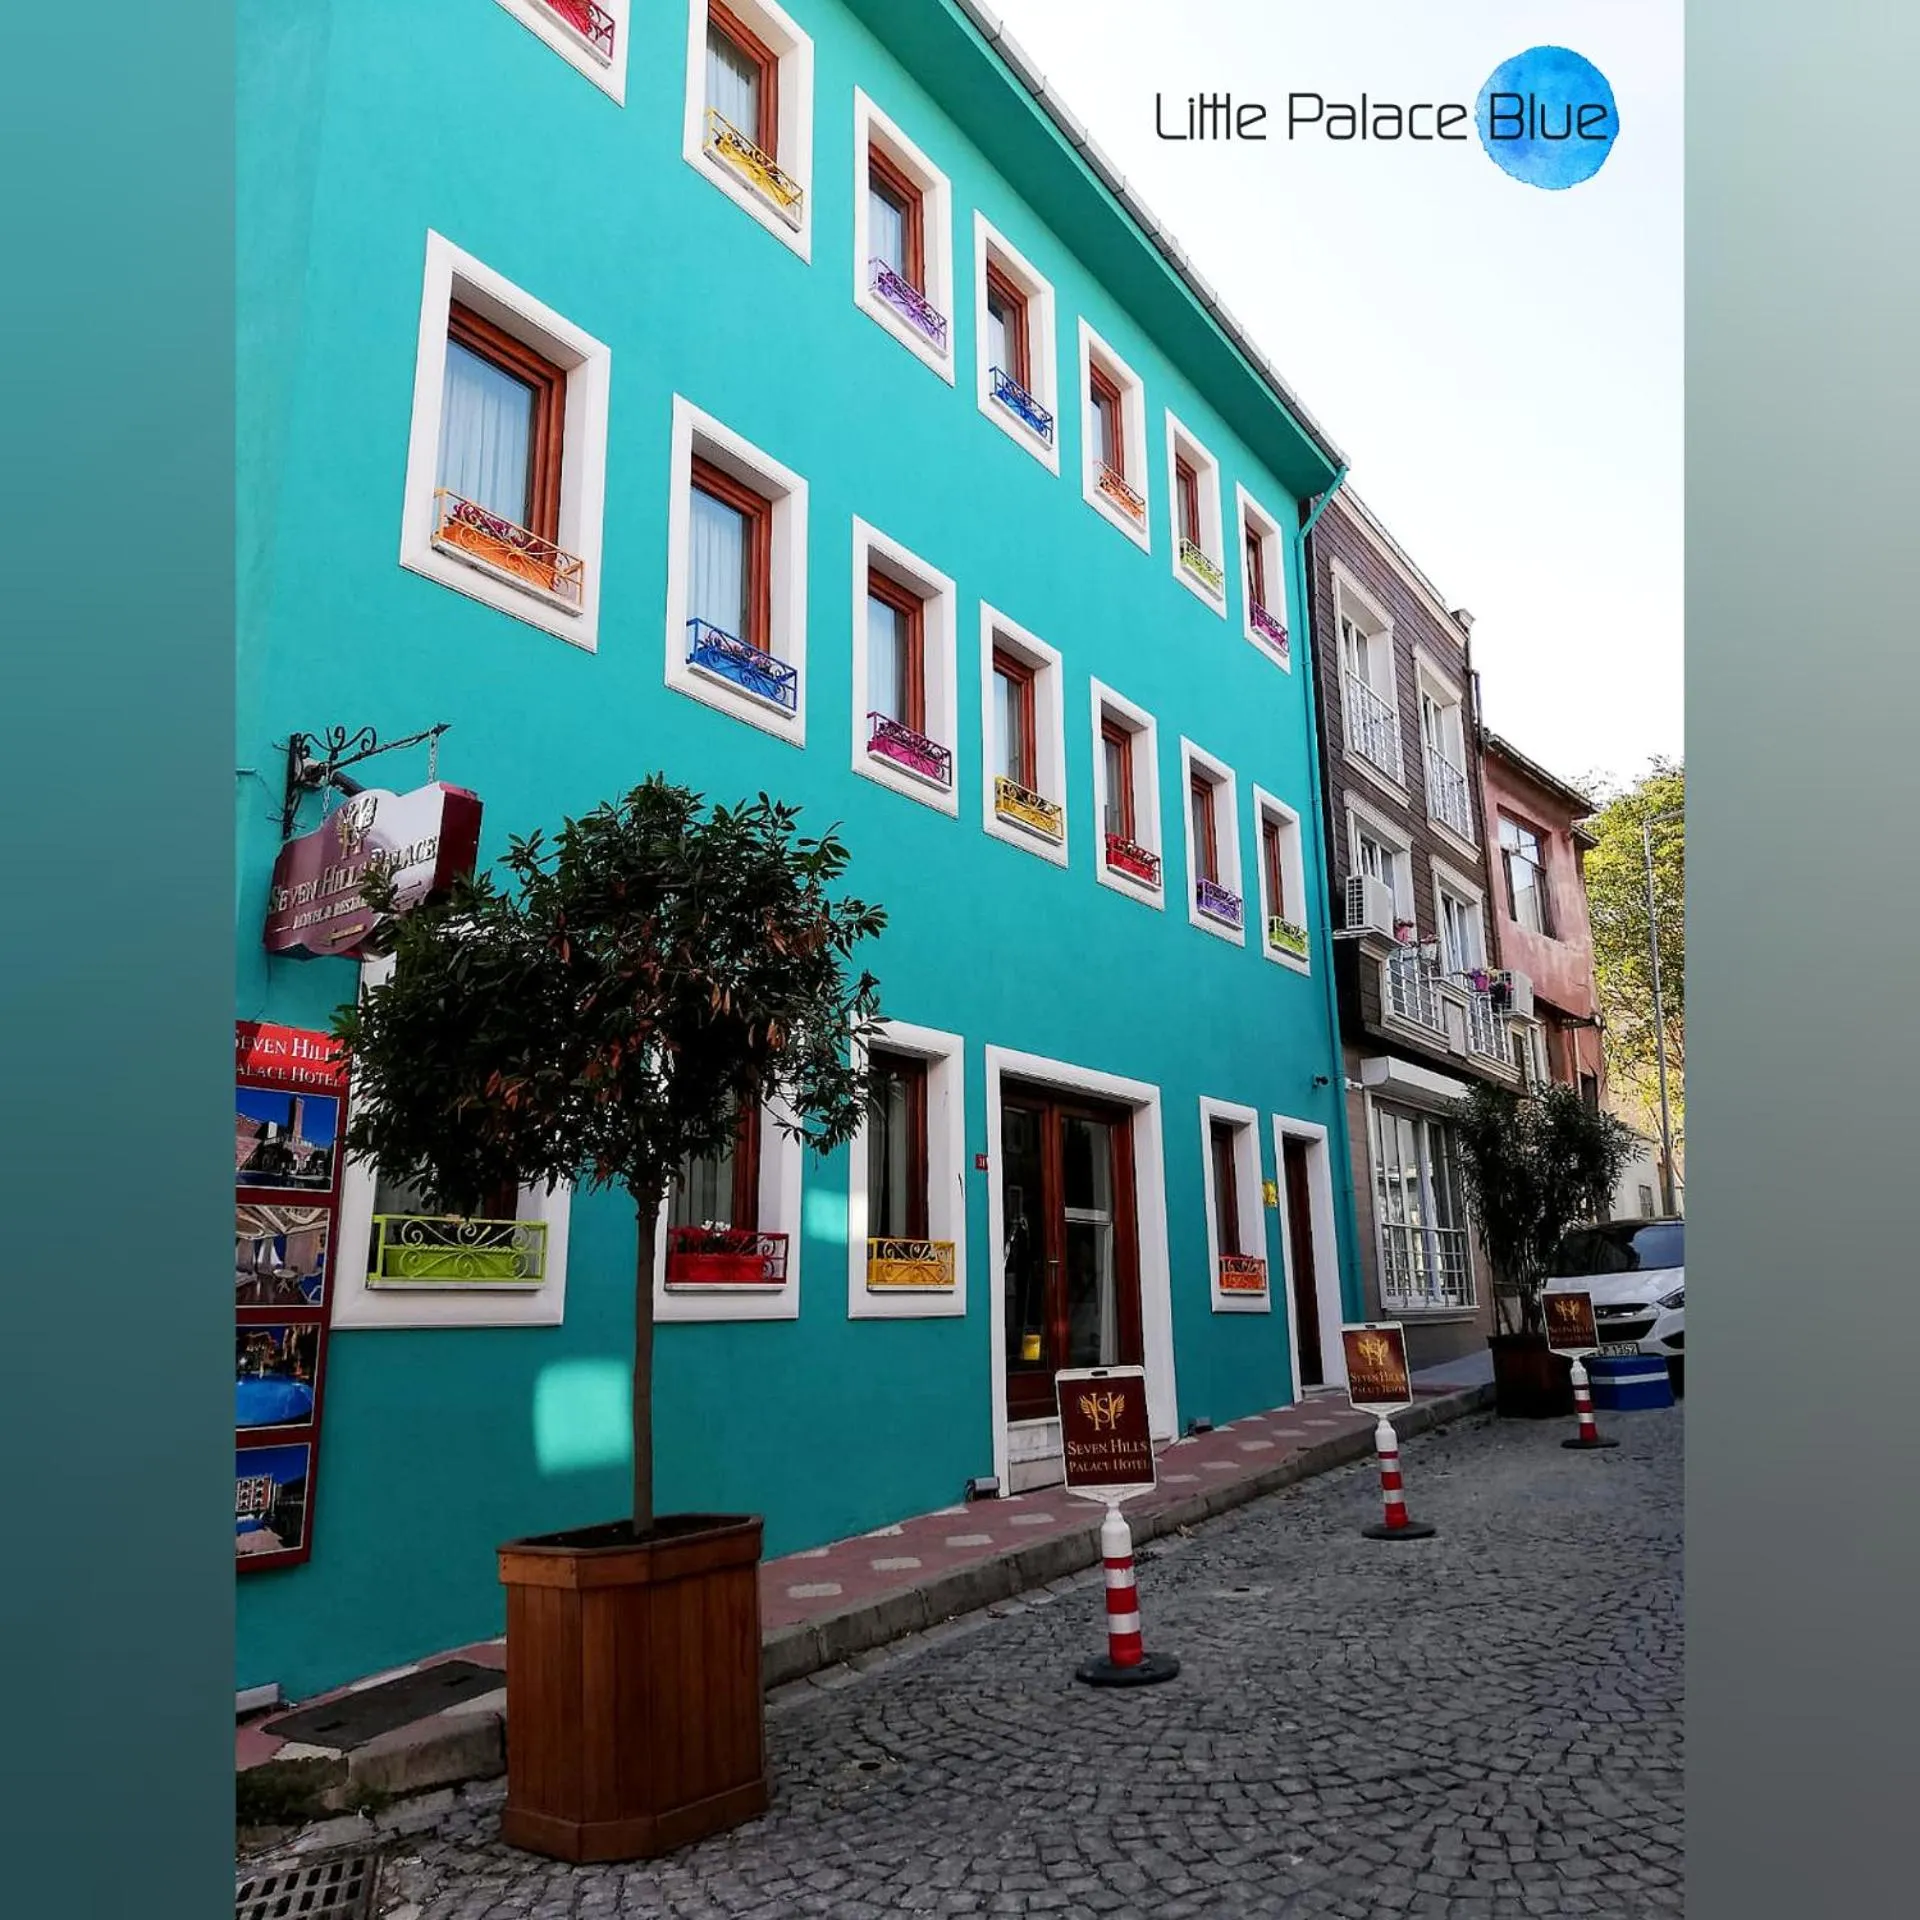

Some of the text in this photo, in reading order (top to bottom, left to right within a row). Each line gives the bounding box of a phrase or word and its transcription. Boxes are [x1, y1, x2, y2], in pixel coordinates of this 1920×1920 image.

[1067, 1438, 1149, 1455] SEVEN HILLS
[1069, 1458, 1151, 1473] PALACE HOTEL
